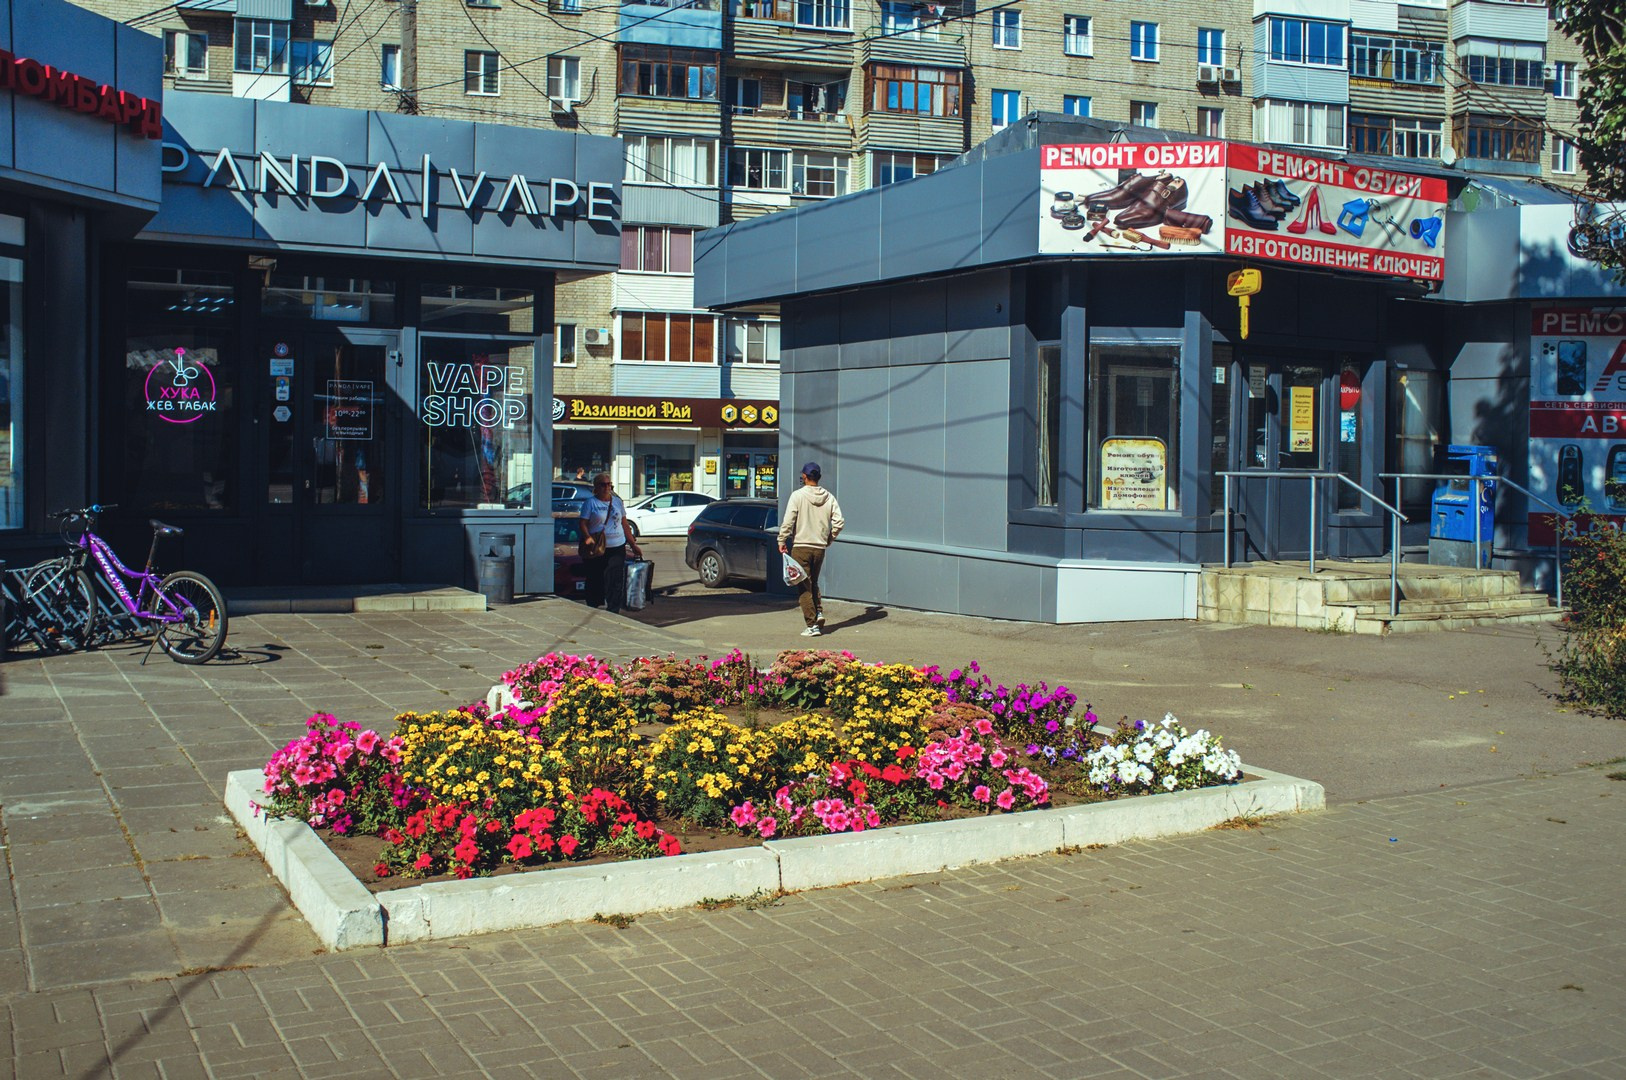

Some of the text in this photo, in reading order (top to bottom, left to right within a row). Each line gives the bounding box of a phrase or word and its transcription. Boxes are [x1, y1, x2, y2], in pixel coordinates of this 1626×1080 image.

[1046, 144, 1220, 167] РЕМОНТ ОБУВИ
[1257, 150, 1422, 198] РЕМОНТ ОБУВИ
[450, 168, 614, 221] VAPE
[1230, 234, 1441, 279] ИЗГОТОВЛЕНИЕ КЛЮЧЕЙ
[160, 386, 201, 399] ХУКА
[426, 362, 525, 397] VAPE
[178, 400, 217, 411] ТАБАК
[422, 394, 526, 429] SHOP
